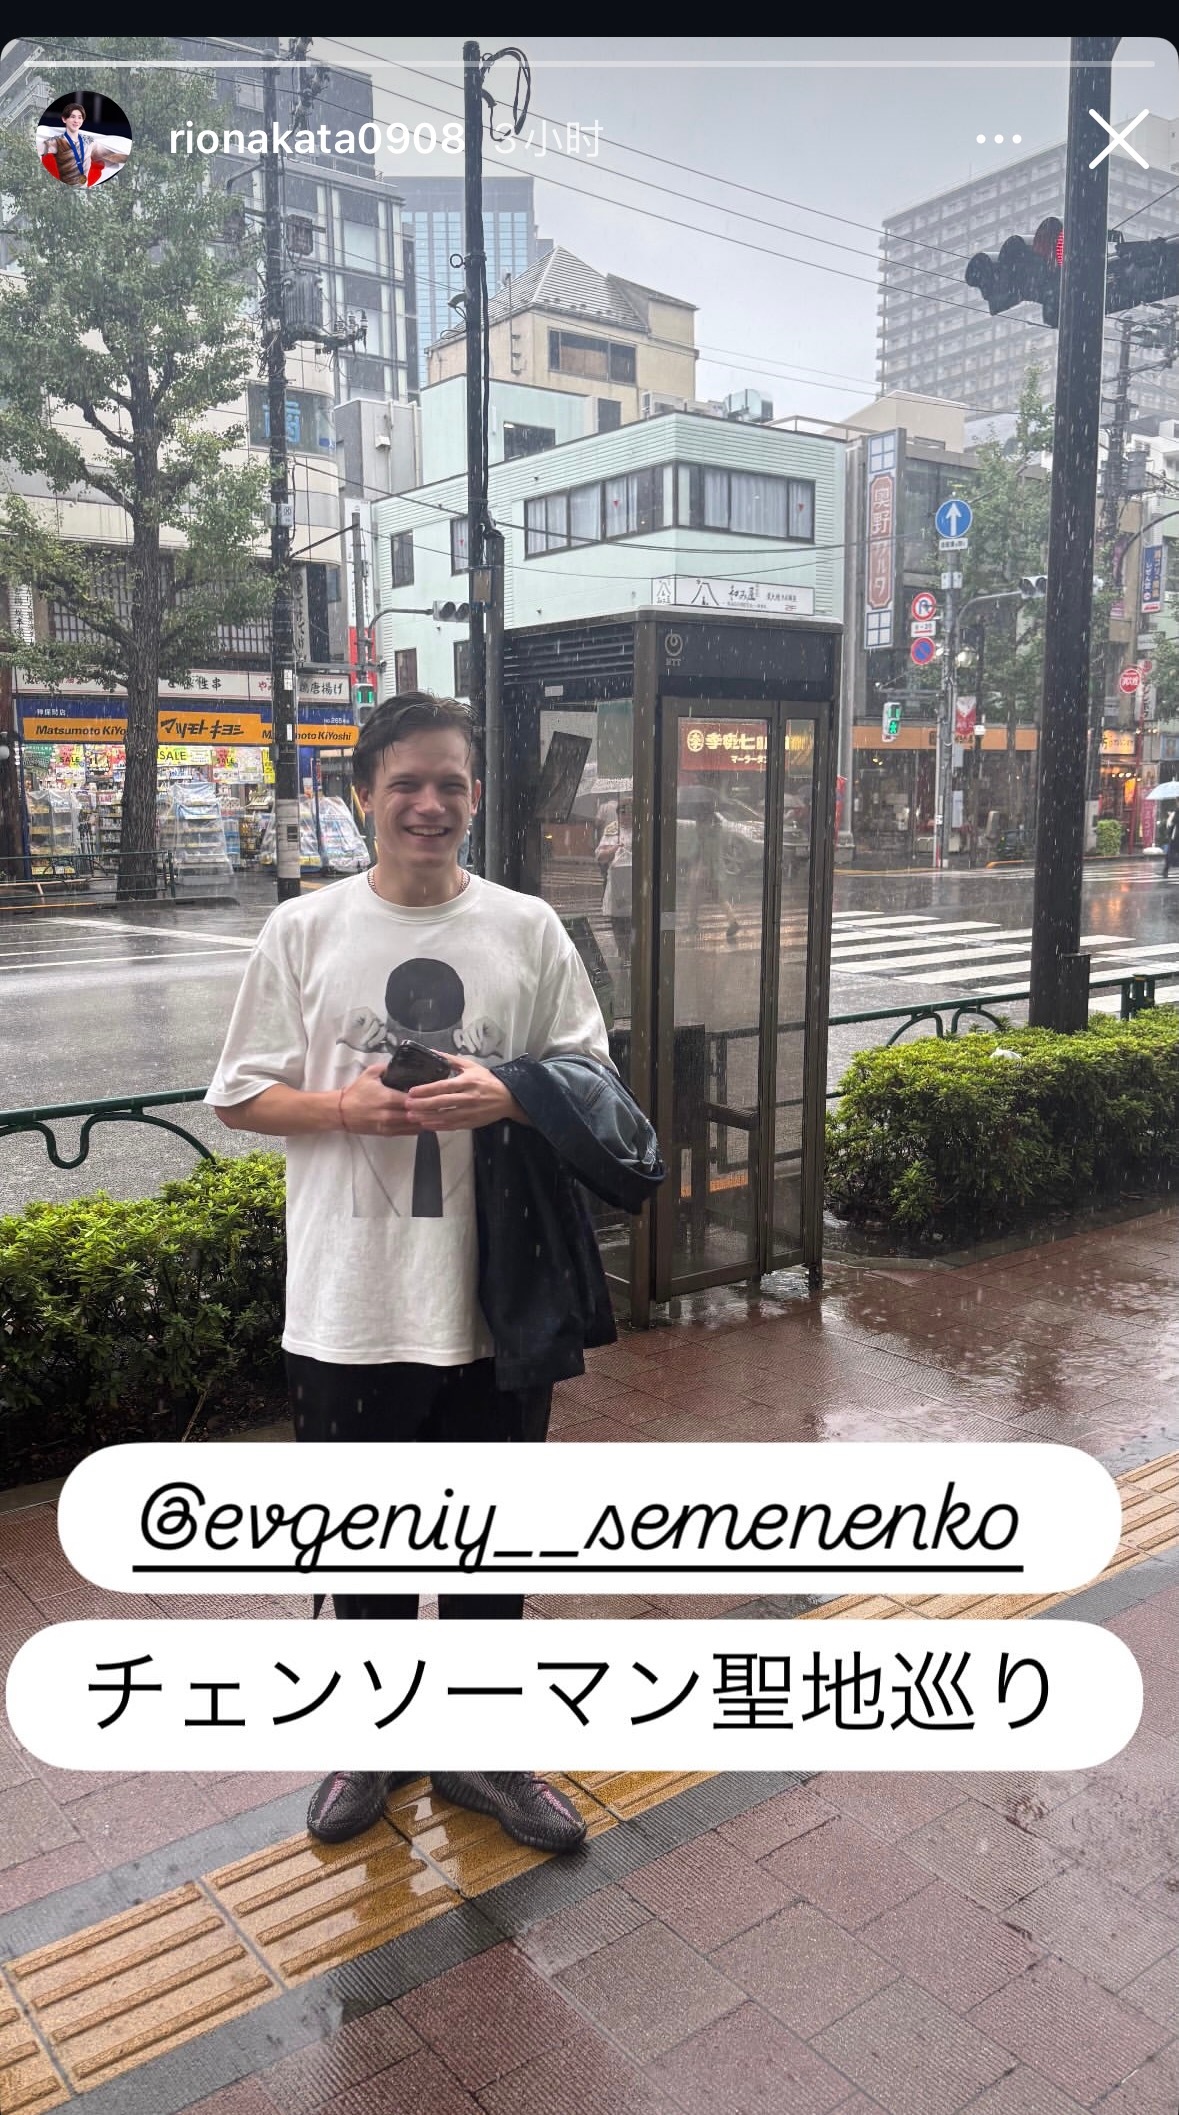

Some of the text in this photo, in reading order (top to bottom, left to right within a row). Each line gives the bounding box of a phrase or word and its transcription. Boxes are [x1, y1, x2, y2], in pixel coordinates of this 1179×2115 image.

[36, 725, 127, 736] Matsumoto KiYo
[318, 731, 352, 741] KiYoshi
[160, 750, 187, 761] SALE
